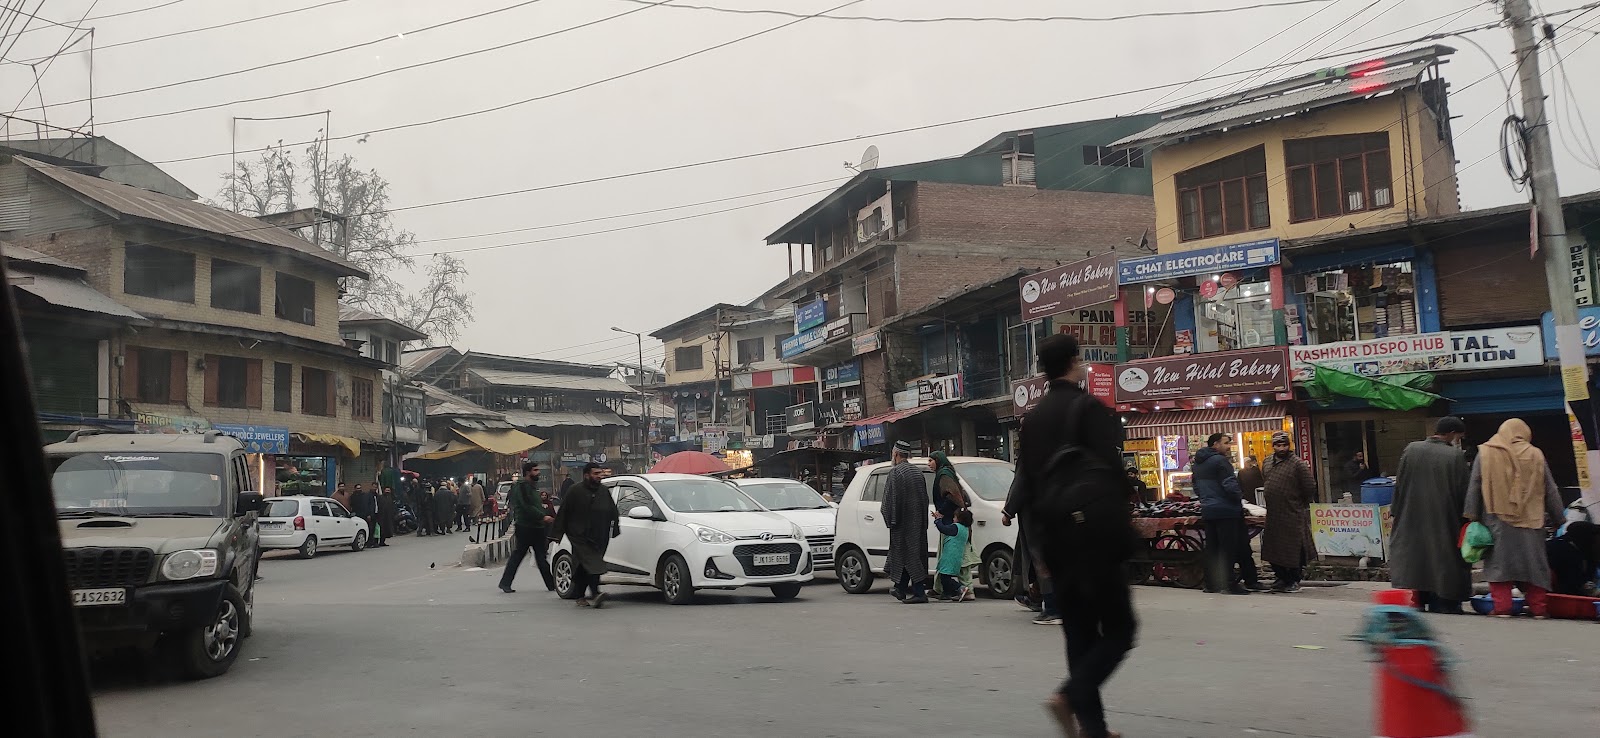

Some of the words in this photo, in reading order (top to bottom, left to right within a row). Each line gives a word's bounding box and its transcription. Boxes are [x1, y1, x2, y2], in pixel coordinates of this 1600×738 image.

[1135, 262, 1163, 275] CHAT
[1166, 250, 1245, 271] ELECTROCARE
[1040, 278, 1056, 294] New
[1059, 269, 1082, 289] Hilal
[1083, 263, 1114, 283] Bakery
[1079, 310, 1156, 323] PAINERS
[1294, 344, 1358, 361] KASHMIR
[1362, 340, 1408, 356] DISPO
[1412, 337, 1445, 351] HUB
[1153, 366, 1180, 385] New
[1185, 362, 1227, 381] Hilal
[1229, 358, 1281, 380] Bakery
[1029, 383, 1043, 401] New
[231, 431, 254, 440] CHOICE
[254, 432, 286, 441] JEWELLERS
[1315, 509, 1374, 519] QAYOOM
[1316, 519, 1350, 527] POULTRY
